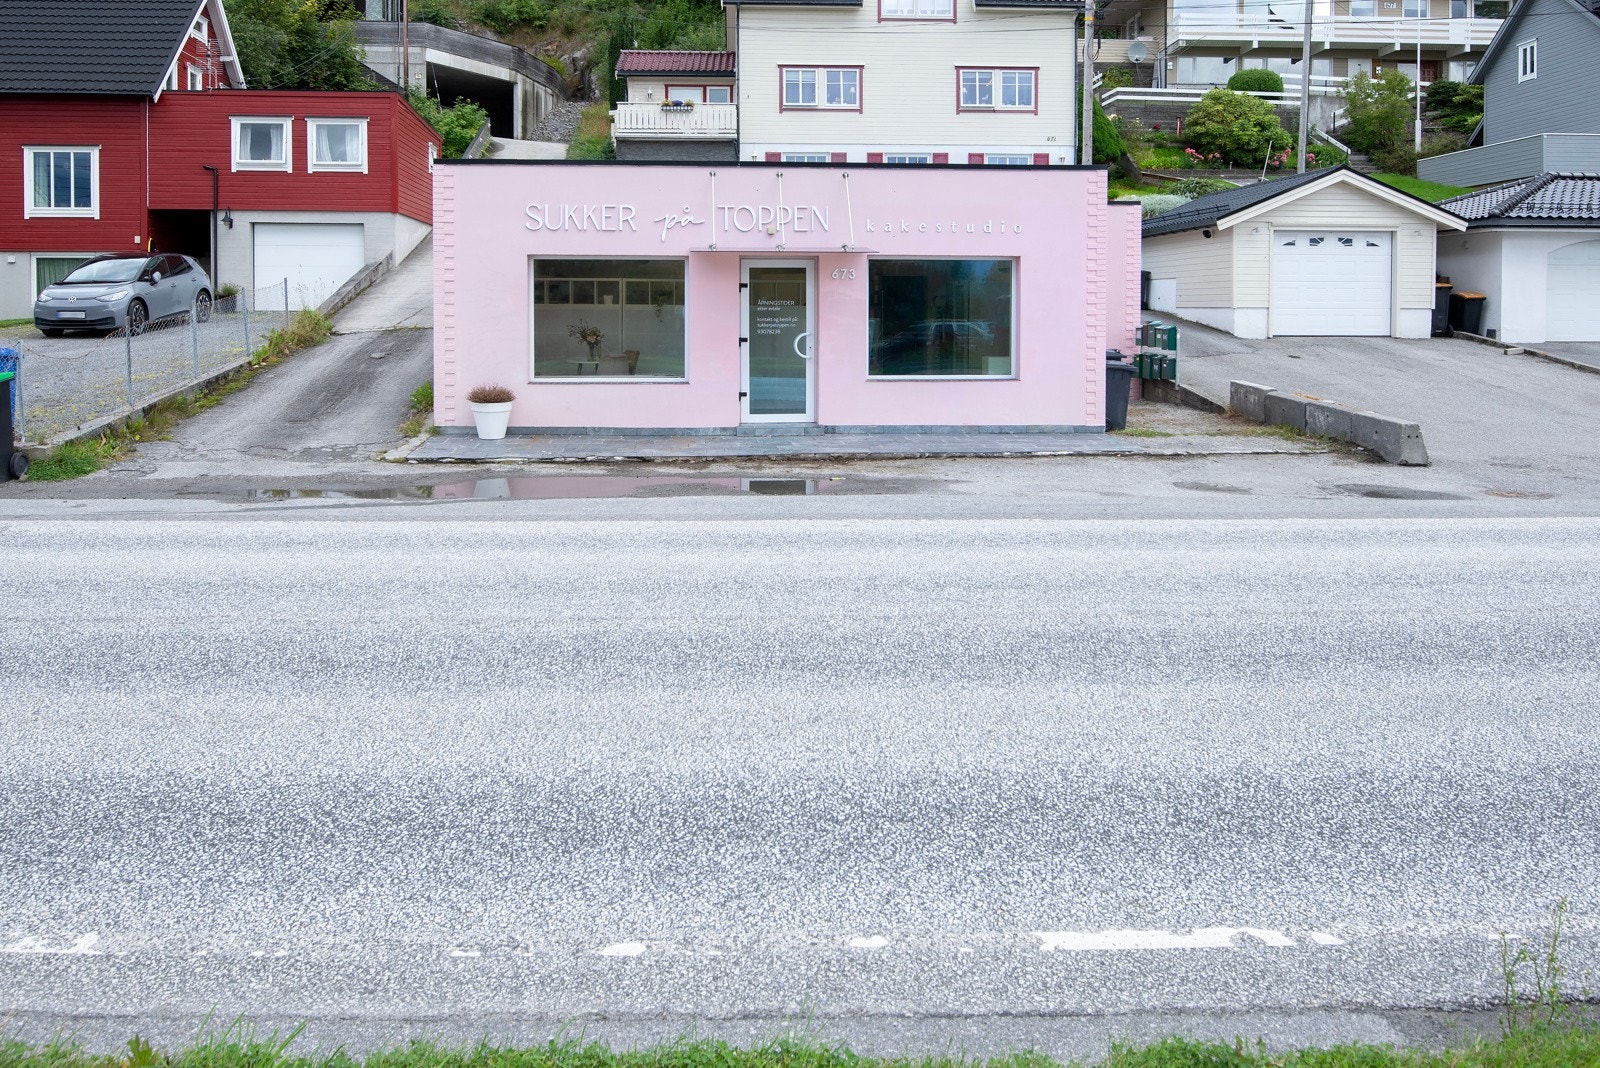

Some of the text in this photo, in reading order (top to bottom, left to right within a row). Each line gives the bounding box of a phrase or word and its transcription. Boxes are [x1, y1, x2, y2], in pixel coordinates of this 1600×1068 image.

[525, 204, 830, 242] SUKKER på TOPPEN
[866, 219, 1024, 234] kakestudio
[831, 267, 856, 280] 673
